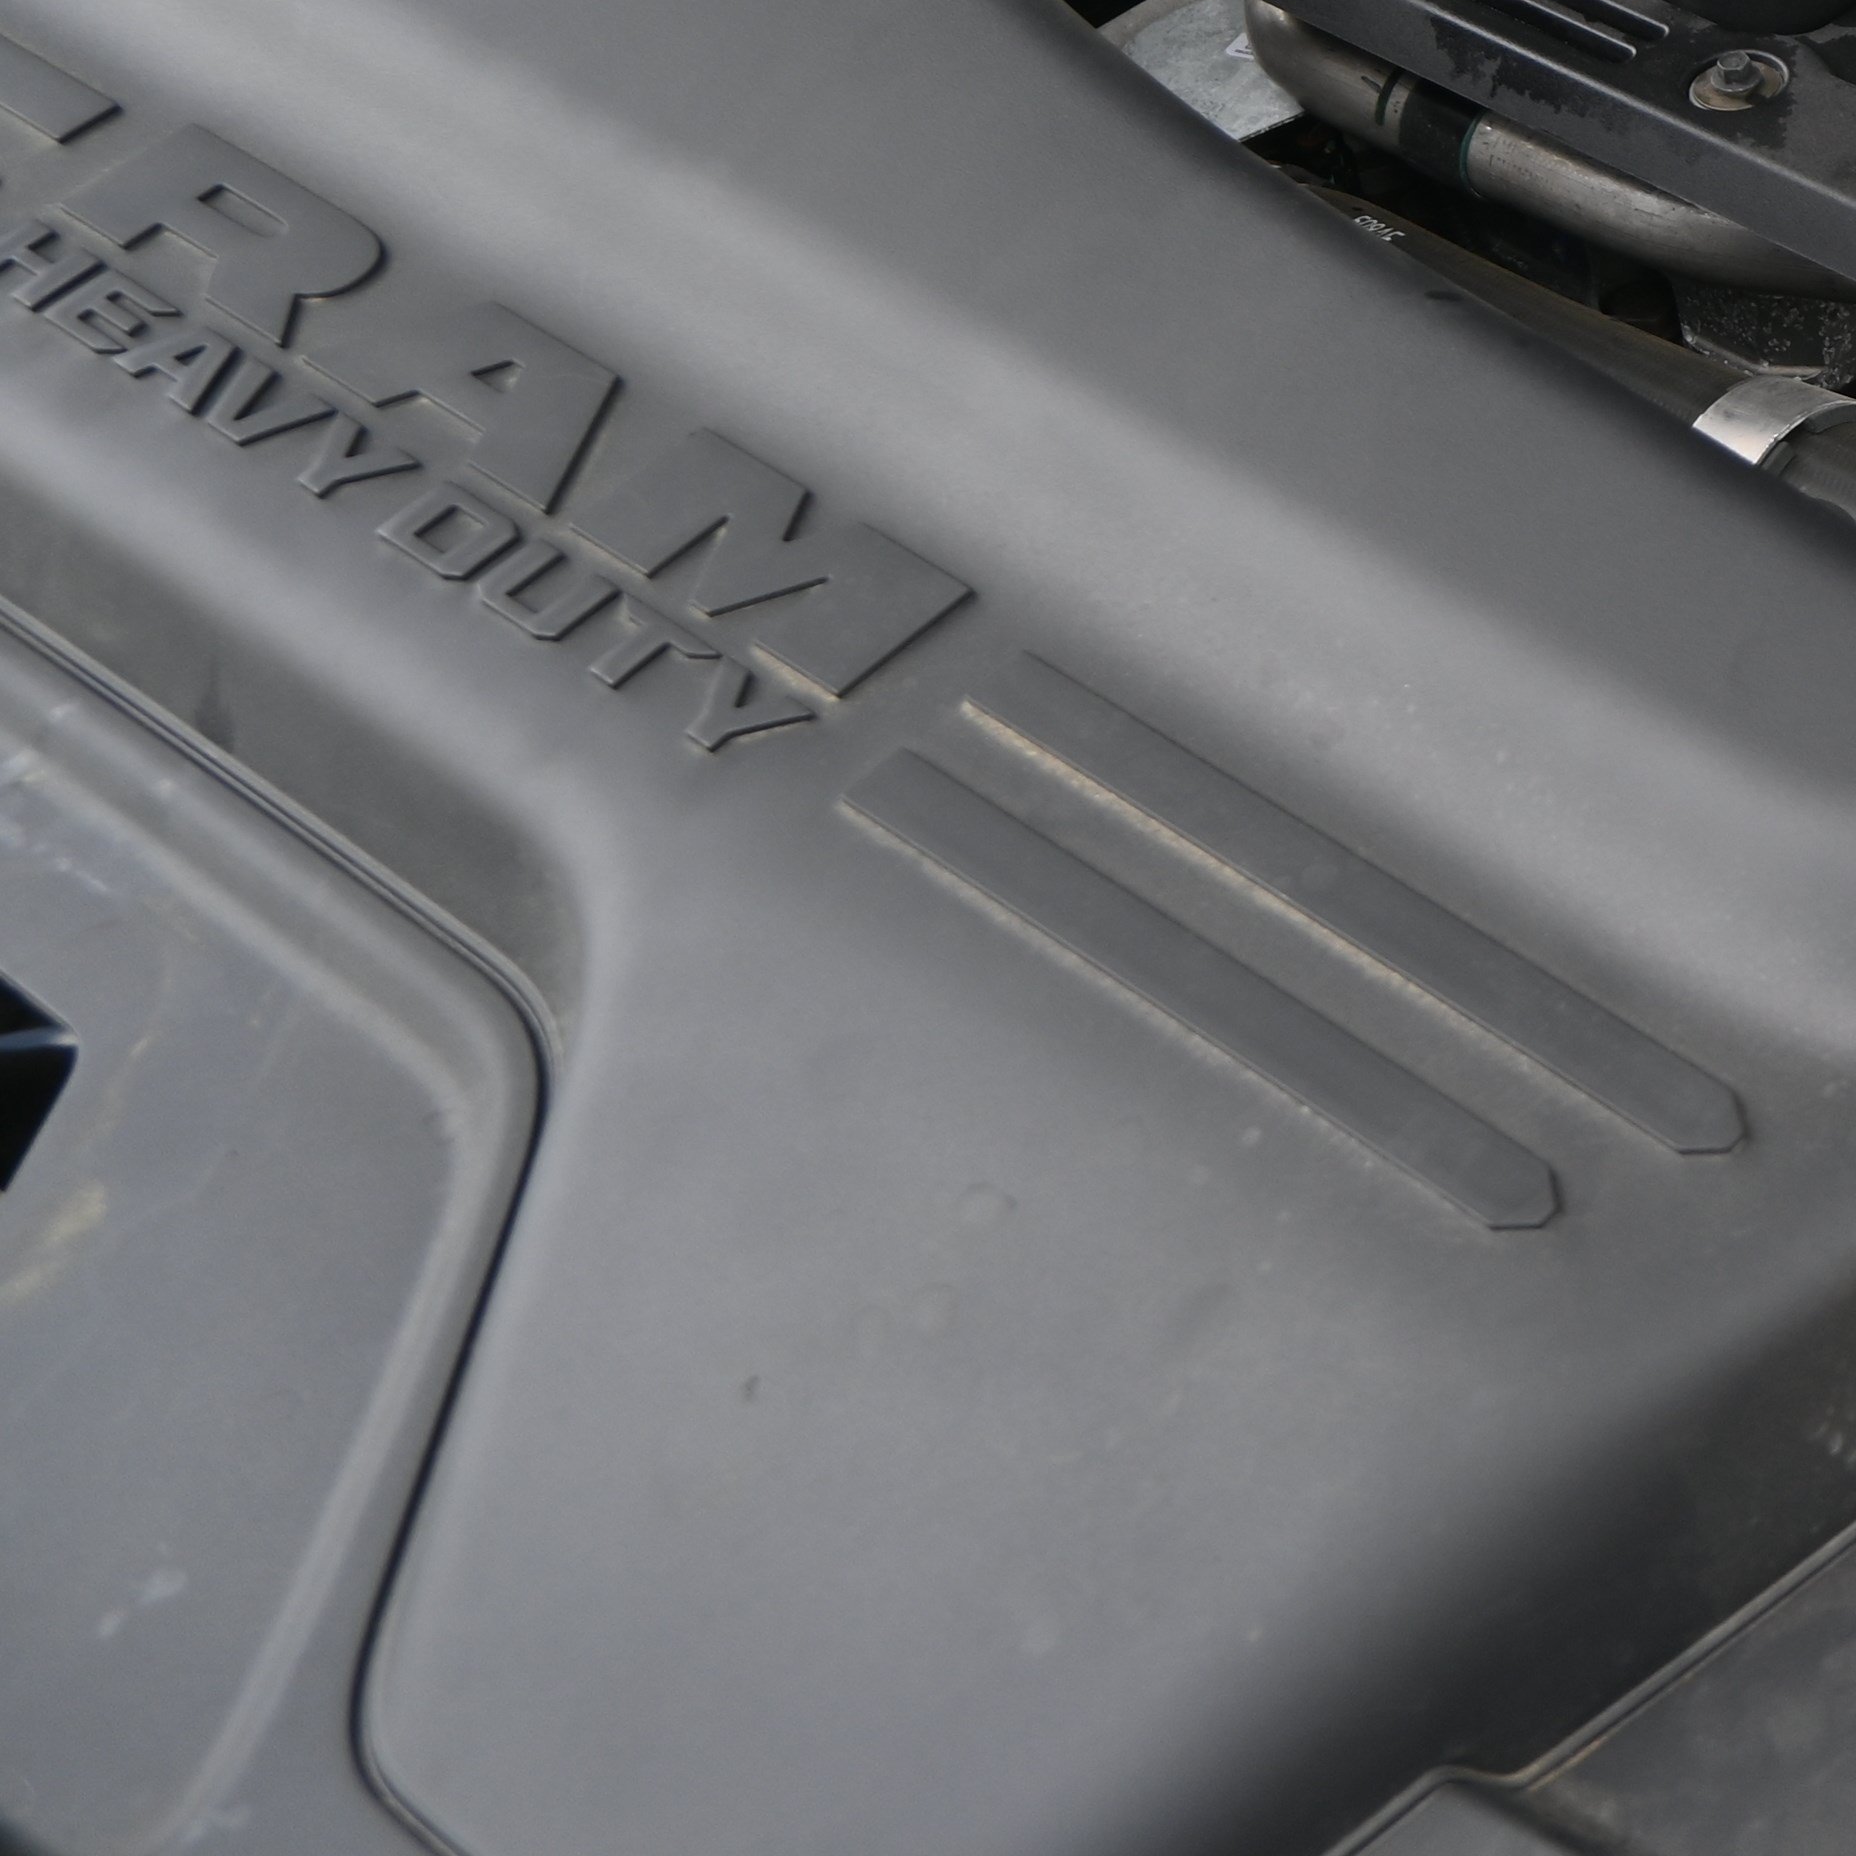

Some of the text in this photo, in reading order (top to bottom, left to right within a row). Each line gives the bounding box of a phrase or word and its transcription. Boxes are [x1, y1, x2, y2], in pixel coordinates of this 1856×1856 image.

[0, 220, 818, 752] HEAVY DUTY
[58, 122, 978, 699] RAM
